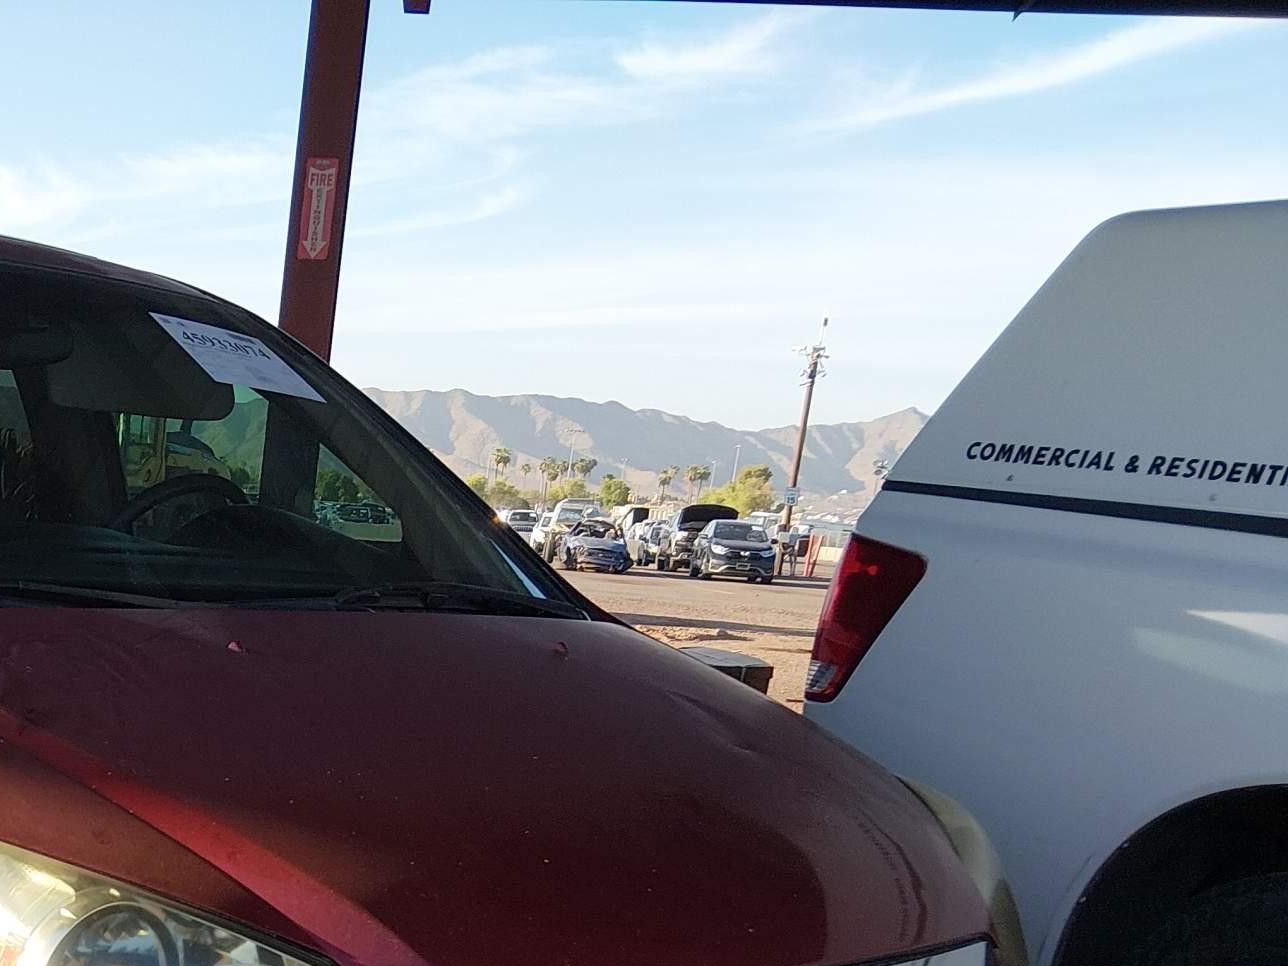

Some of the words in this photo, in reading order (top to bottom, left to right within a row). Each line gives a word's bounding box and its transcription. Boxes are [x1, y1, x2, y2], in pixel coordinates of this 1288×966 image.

[310, 172, 335, 188] FIRE
[181, 330, 272, 361] 45933074
[966, 441, 1115, 471] COMMERCIAL
[1124, 454, 1140, 474] &
